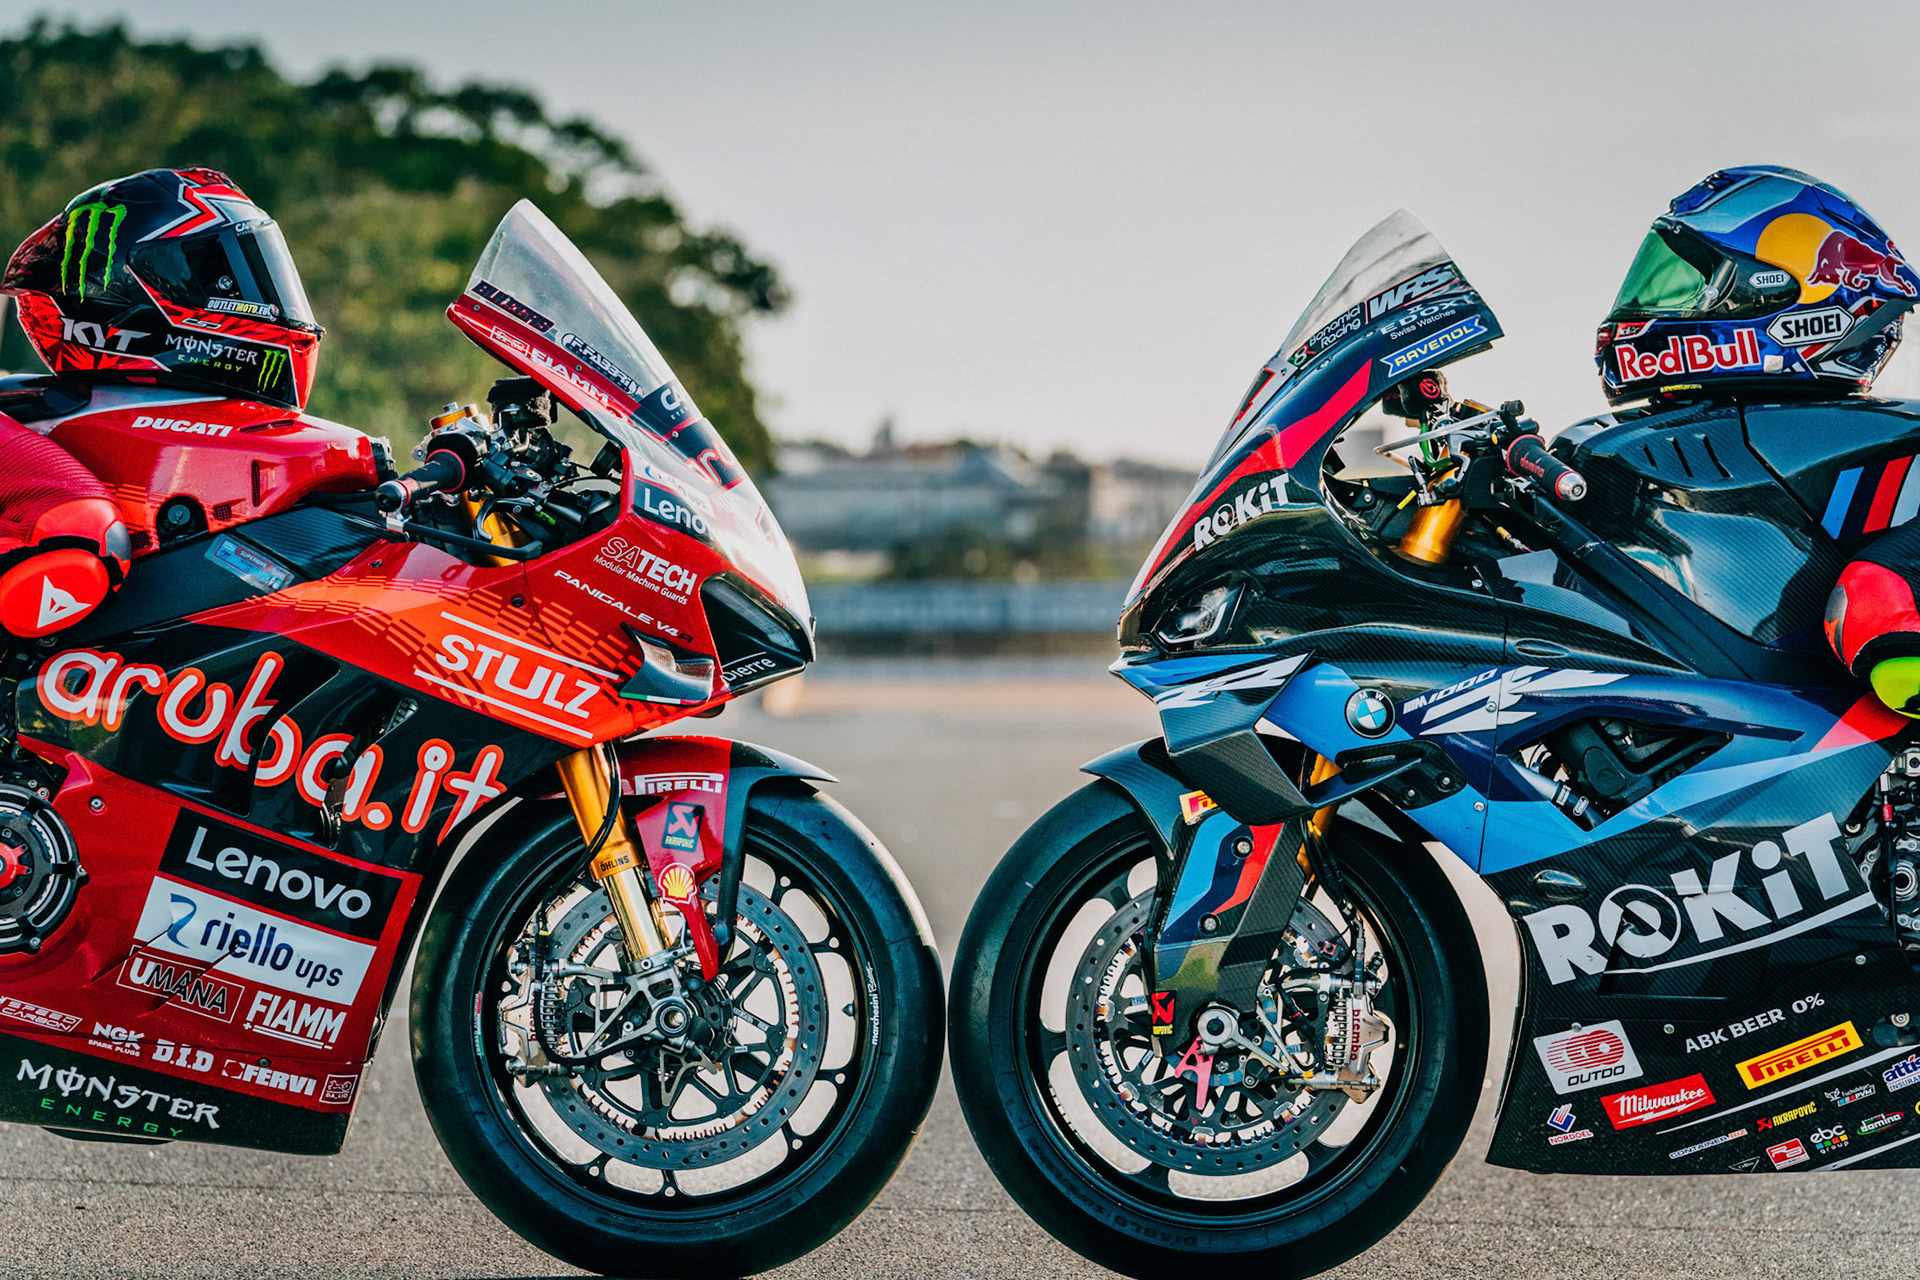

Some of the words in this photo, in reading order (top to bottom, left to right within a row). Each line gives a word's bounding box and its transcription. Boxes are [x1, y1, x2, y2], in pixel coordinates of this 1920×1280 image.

[1369, 265, 1455, 319] WRS
[1756, 273, 1785, 285] SHOEI
[207, 299, 270, 317] OUTLETMOTO.EU
[1380, 299, 1459, 335] EDOX
[1390, 324, 1417, 340] Swiss
[1417, 308, 1456, 328] Watches
[59, 316, 150, 351] KYT
[1320, 318, 1361, 348] Racing
[1781, 313, 1842, 340] SHOEI
[165, 333, 257, 366] MONSTER
[1394, 324, 1474, 367] RAVENOL
[1615, 335, 1685, 382] Red
[1682, 327, 1761, 373] Bull
[178, 354, 243, 373] ENERGY
[530, 348, 609, 403] FIAMM
[132, 416, 233, 437] DUCATI
[593, 555, 626, 576] Modular
[626, 570, 660, 593] Machine
[661, 588, 688, 606] Guards
[601, 537, 697, 596] SATECH
[554, 570, 654, 624] PANIGALE
[436, 635, 600, 719] STULZ
[1350, 691, 1383, 712] BMW
[37, 649, 507, 846] aruba.it
[634, 772, 724, 795] PIRELLI
[186, 826, 371, 919] Lenovo
[200, 912, 293, 971] riello
[295, 959, 344, 989] ups
[129, 958, 227, 1013] UMANA
[1, 1008, 72, 1031] CARBON
[9, 1000, 77, 1024] SPEED
[246, 990, 347, 1043] FIAMM
[868, 993, 881, 1046] marchesini
[1685, 1028, 1728, 1054] ABK
[1732, 1008, 1787, 1040] BEER
[1791, 992, 1825, 1015] 0%
[88, 1039, 113, 1050] SPARK
[115, 1046, 140, 1057] PLUGS
[93, 1022, 146, 1050] NGK
[1349, 1009, 1361, 1061] brembo
[152, 1039, 215, 1073] D.I.D
[1747, 1029, 1851, 1083] PIRELLI
[242, 1066, 317, 1096] FERVI
[1568, 1065, 1625, 1086] OUTDO
[16, 1058, 221, 1130] MONSTER
[1613, 1088, 1706, 1117] Milwaukee
[1855, 1089, 1873, 1099] PVM
[40, 1098, 183, 1136] ENERGY
[1550, 1130, 1592, 1144] NORDOEL
[1810, 1125, 1846, 1144] ebc
[1820, 1141, 1849, 1155] group
